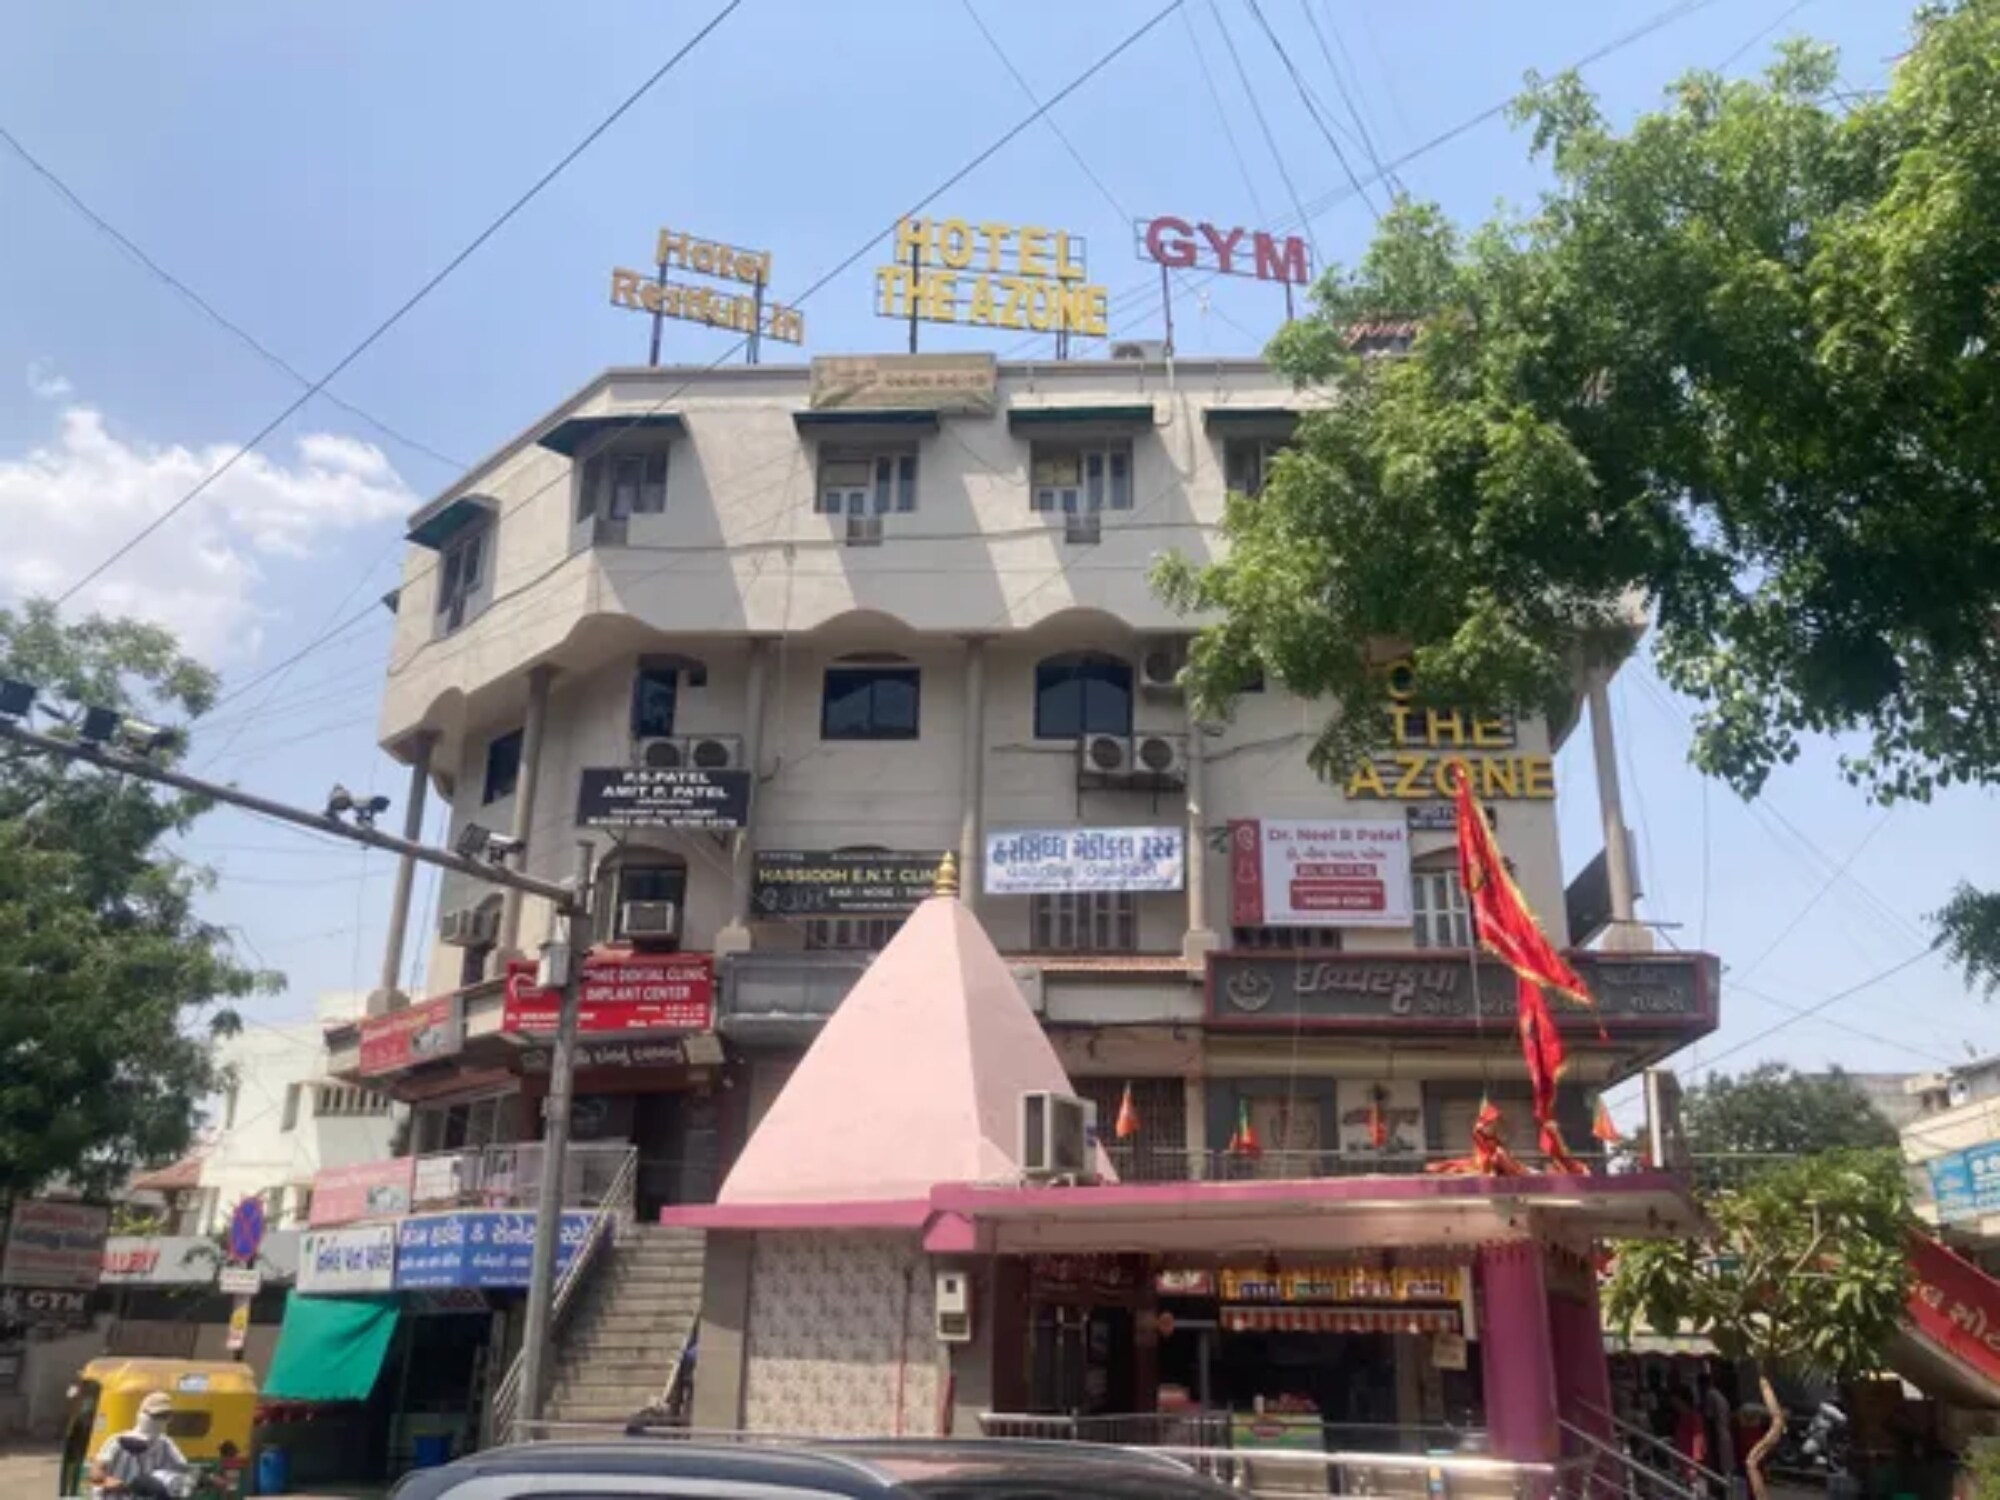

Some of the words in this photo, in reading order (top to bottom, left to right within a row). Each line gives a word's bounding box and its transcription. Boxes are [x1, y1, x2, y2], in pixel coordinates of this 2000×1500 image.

[656, 227, 771, 286] Hotel
[897, 215, 1085, 280] HOTEL
[1146, 216, 1307, 285] GYM
[876, 266, 956, 322] THE
[970, 273, 1107, 337] AZONE
[1386, 706, 1509, 747] THE
[601, 785, 648, 798] AMIT
[672, 785, 729, 799] PATEL
[1347, 755, 1556, 798] AZONE
[1267, 828, 1290, 841] Dr.
[1356, 827, 1402, 841] Patel
